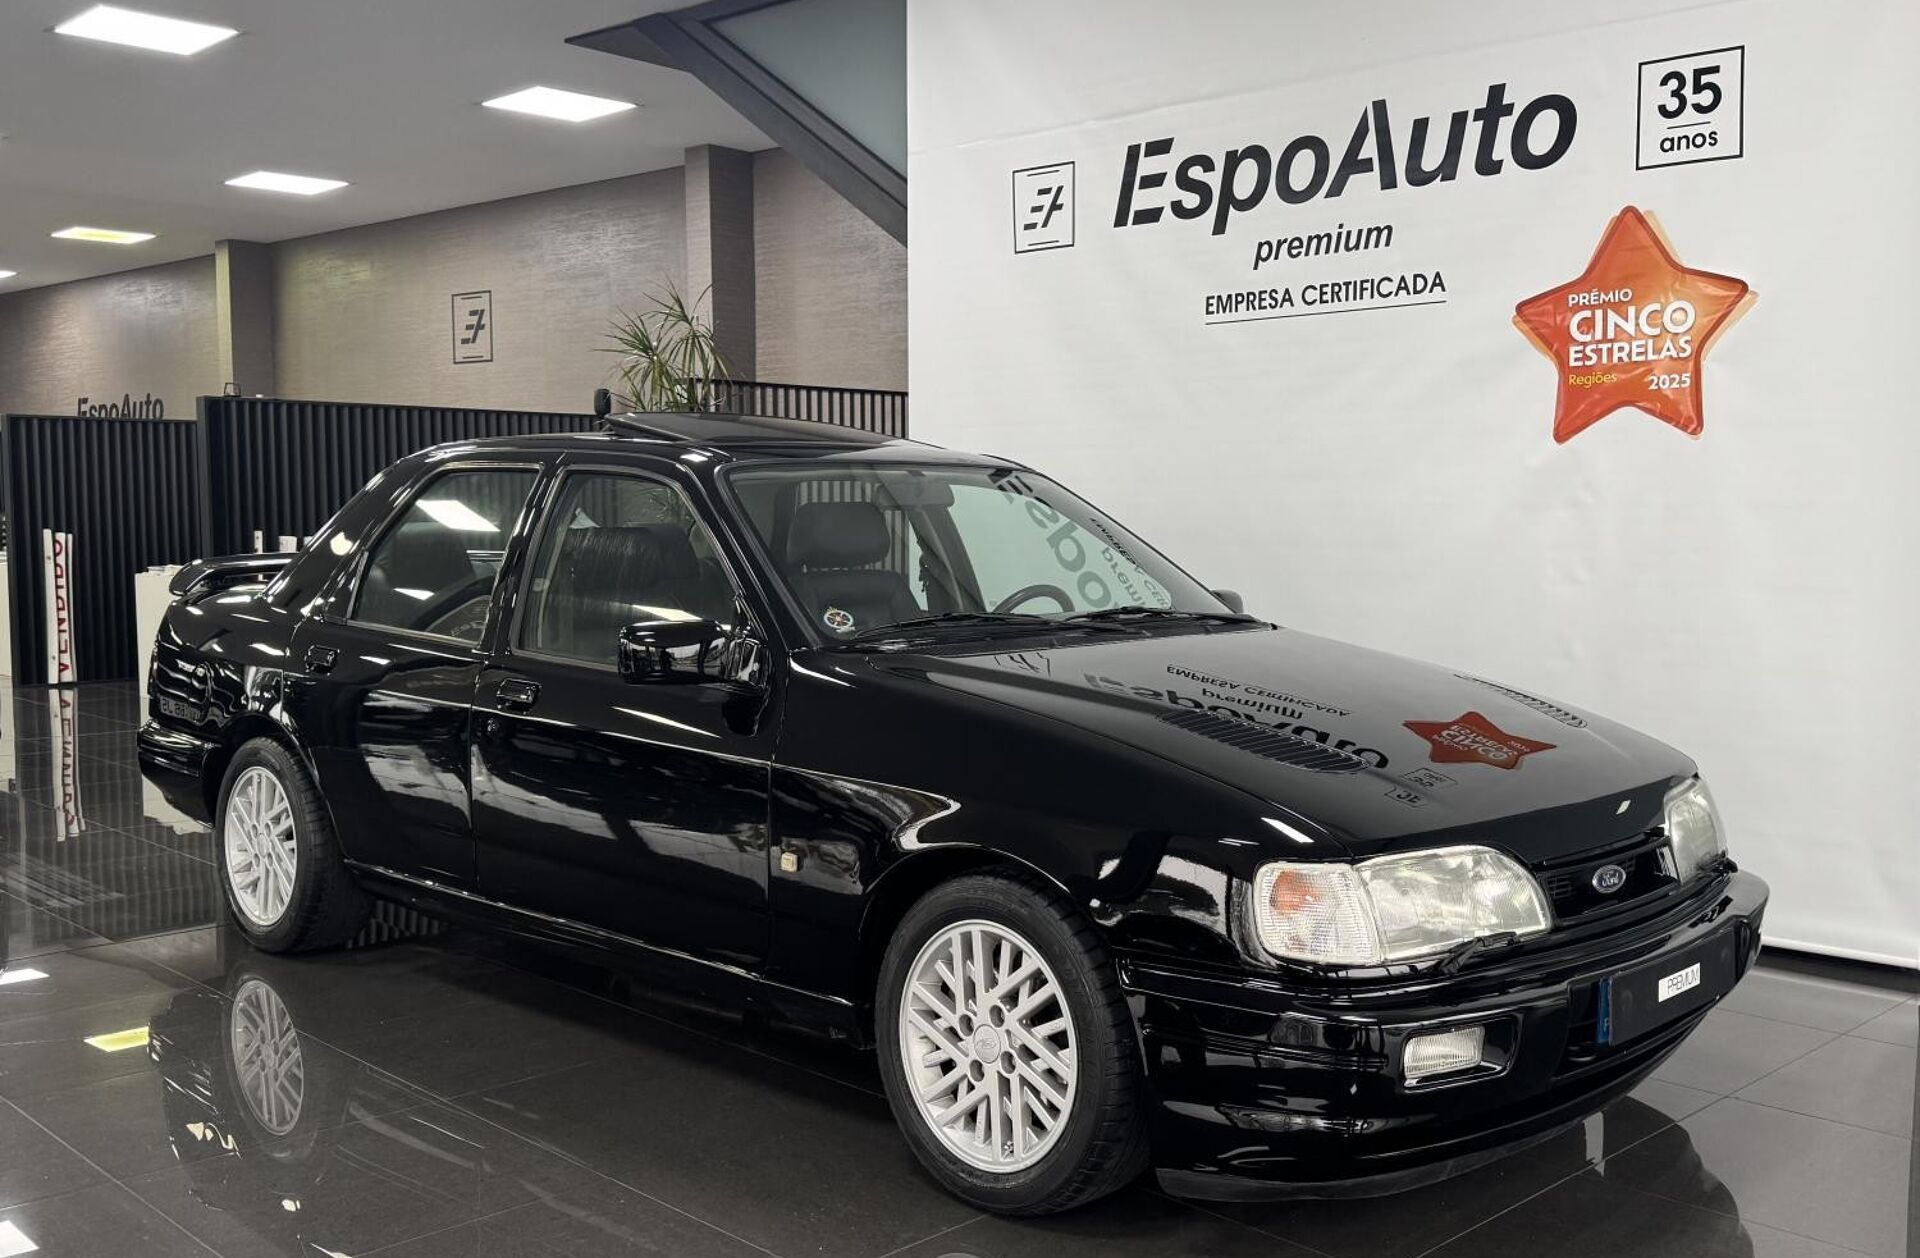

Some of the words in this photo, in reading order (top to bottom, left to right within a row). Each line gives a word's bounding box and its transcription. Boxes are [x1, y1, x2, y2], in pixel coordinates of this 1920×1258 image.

[1658, 64, 1722, 120] 35
[1114, 83, 1577, 236] EspoAuto
[1660, 129, 1719, 154] anos
[1253, 223, 1394, 271] premium
[1205, 288, 1294, 316] EMPRESA
[1301, 271, 1446, 306] CERTIFICADA
[1568, 288, 1633, 307] PRÉMIO
[1569, 300, 1696, 342] CINCO
[1568, 335, 1692, 367] ESTRELAS
[1568, 371, 1618, 388] Regiões
[1647, 373, 1691, 390] 2025
